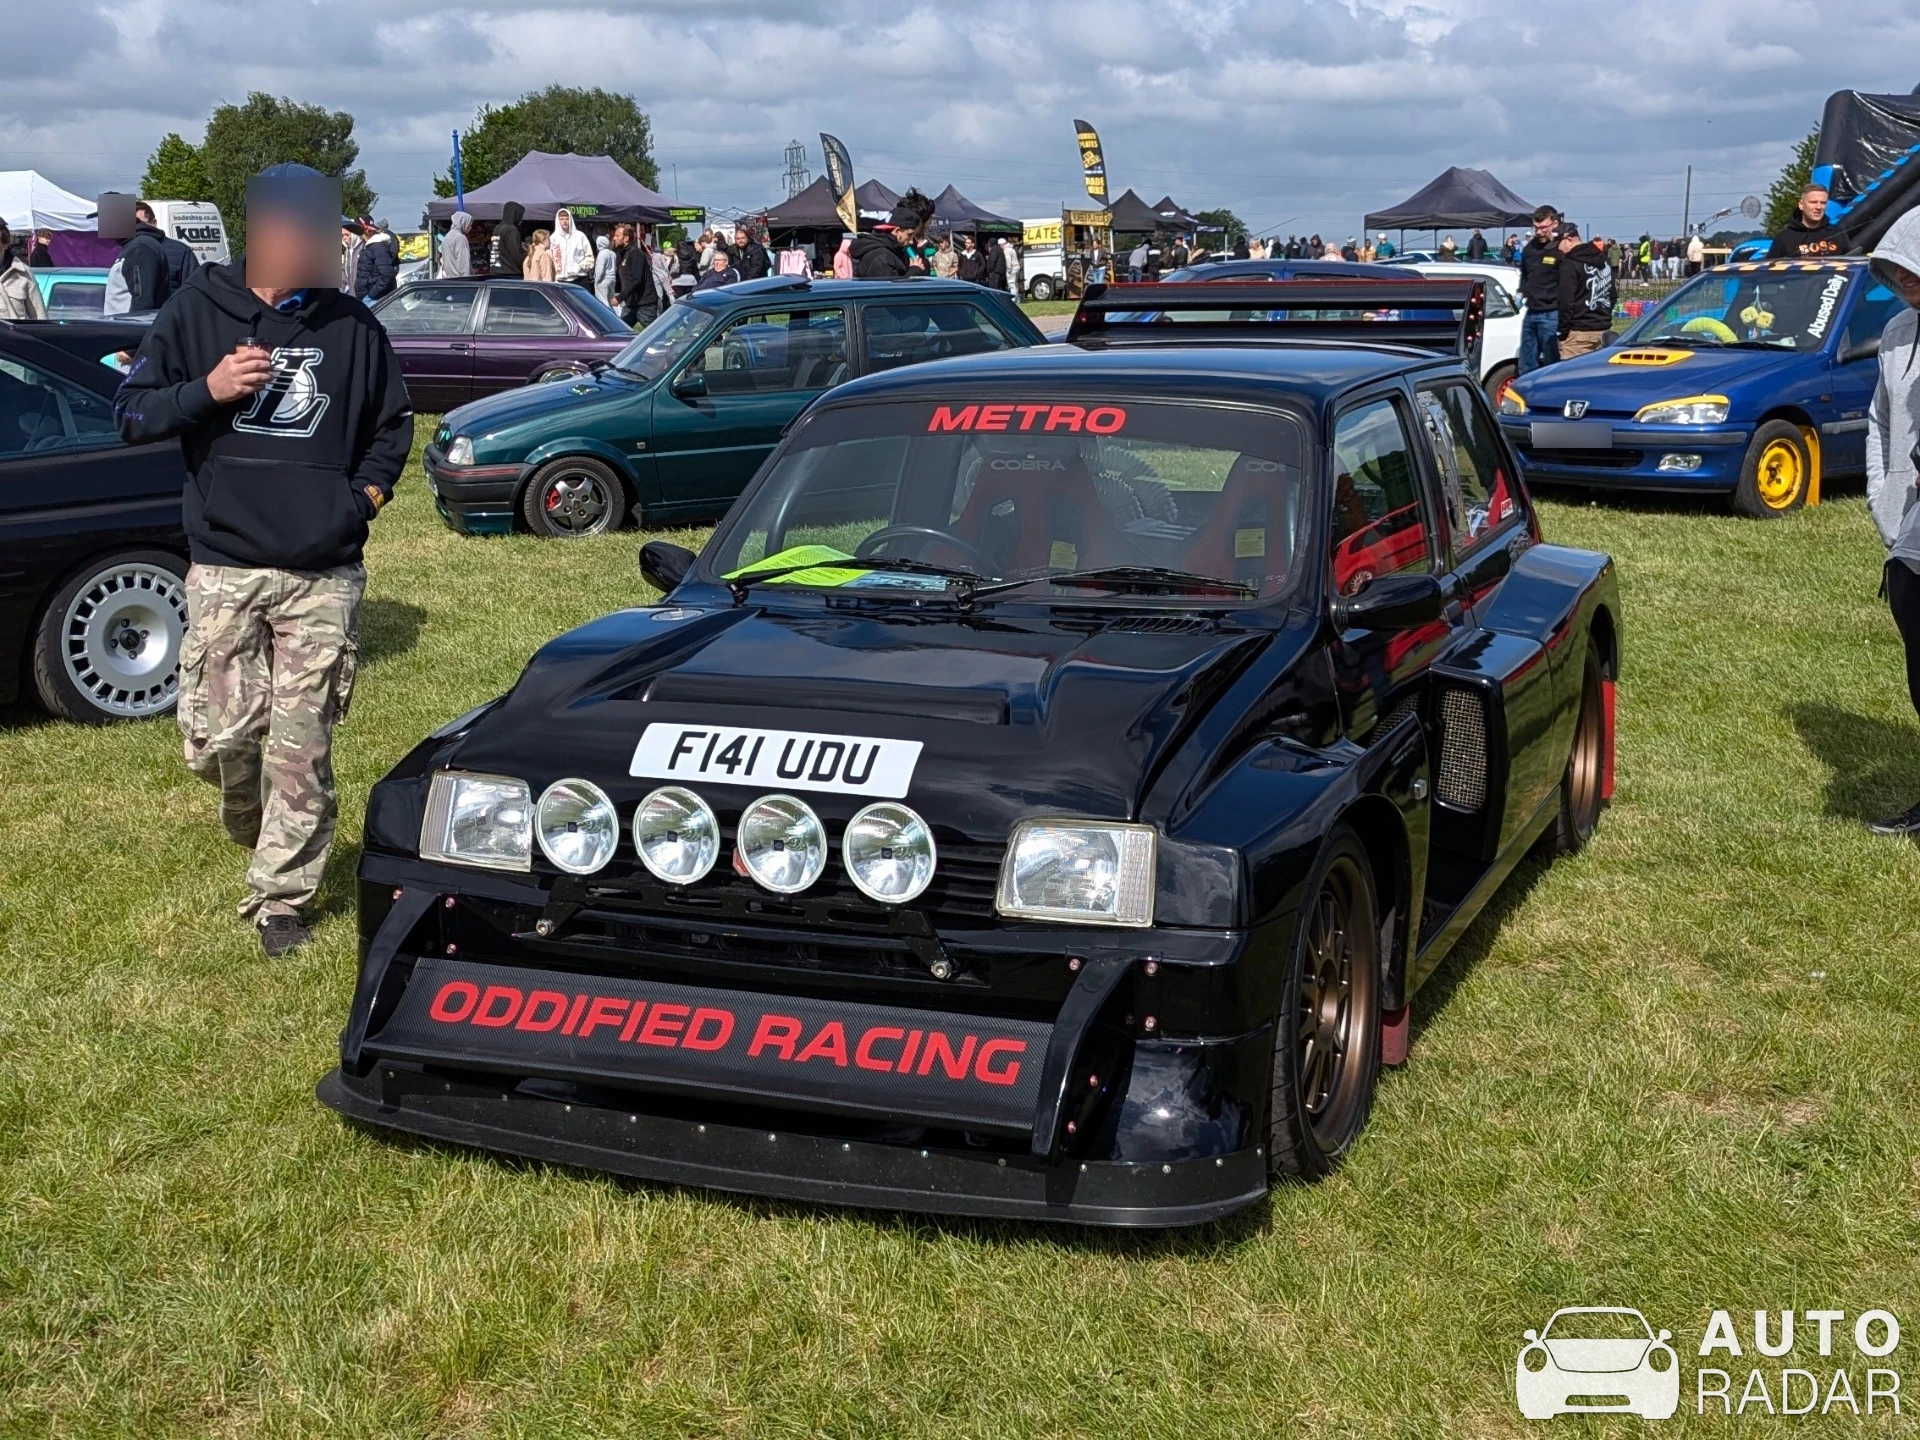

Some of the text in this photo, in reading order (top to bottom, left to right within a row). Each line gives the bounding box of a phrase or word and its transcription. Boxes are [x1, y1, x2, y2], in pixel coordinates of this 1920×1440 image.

[175, 225, 221, 243] kode
[1807, 274, 1848, 338] Abused Daily
[928, 405, 1126, 433] METRO
[990, 459, 1066, 471] COBRA
[667, 731, 881, 785] F141 UDU
[430, 981, 1027, 1086] ODDIFIED RACING
